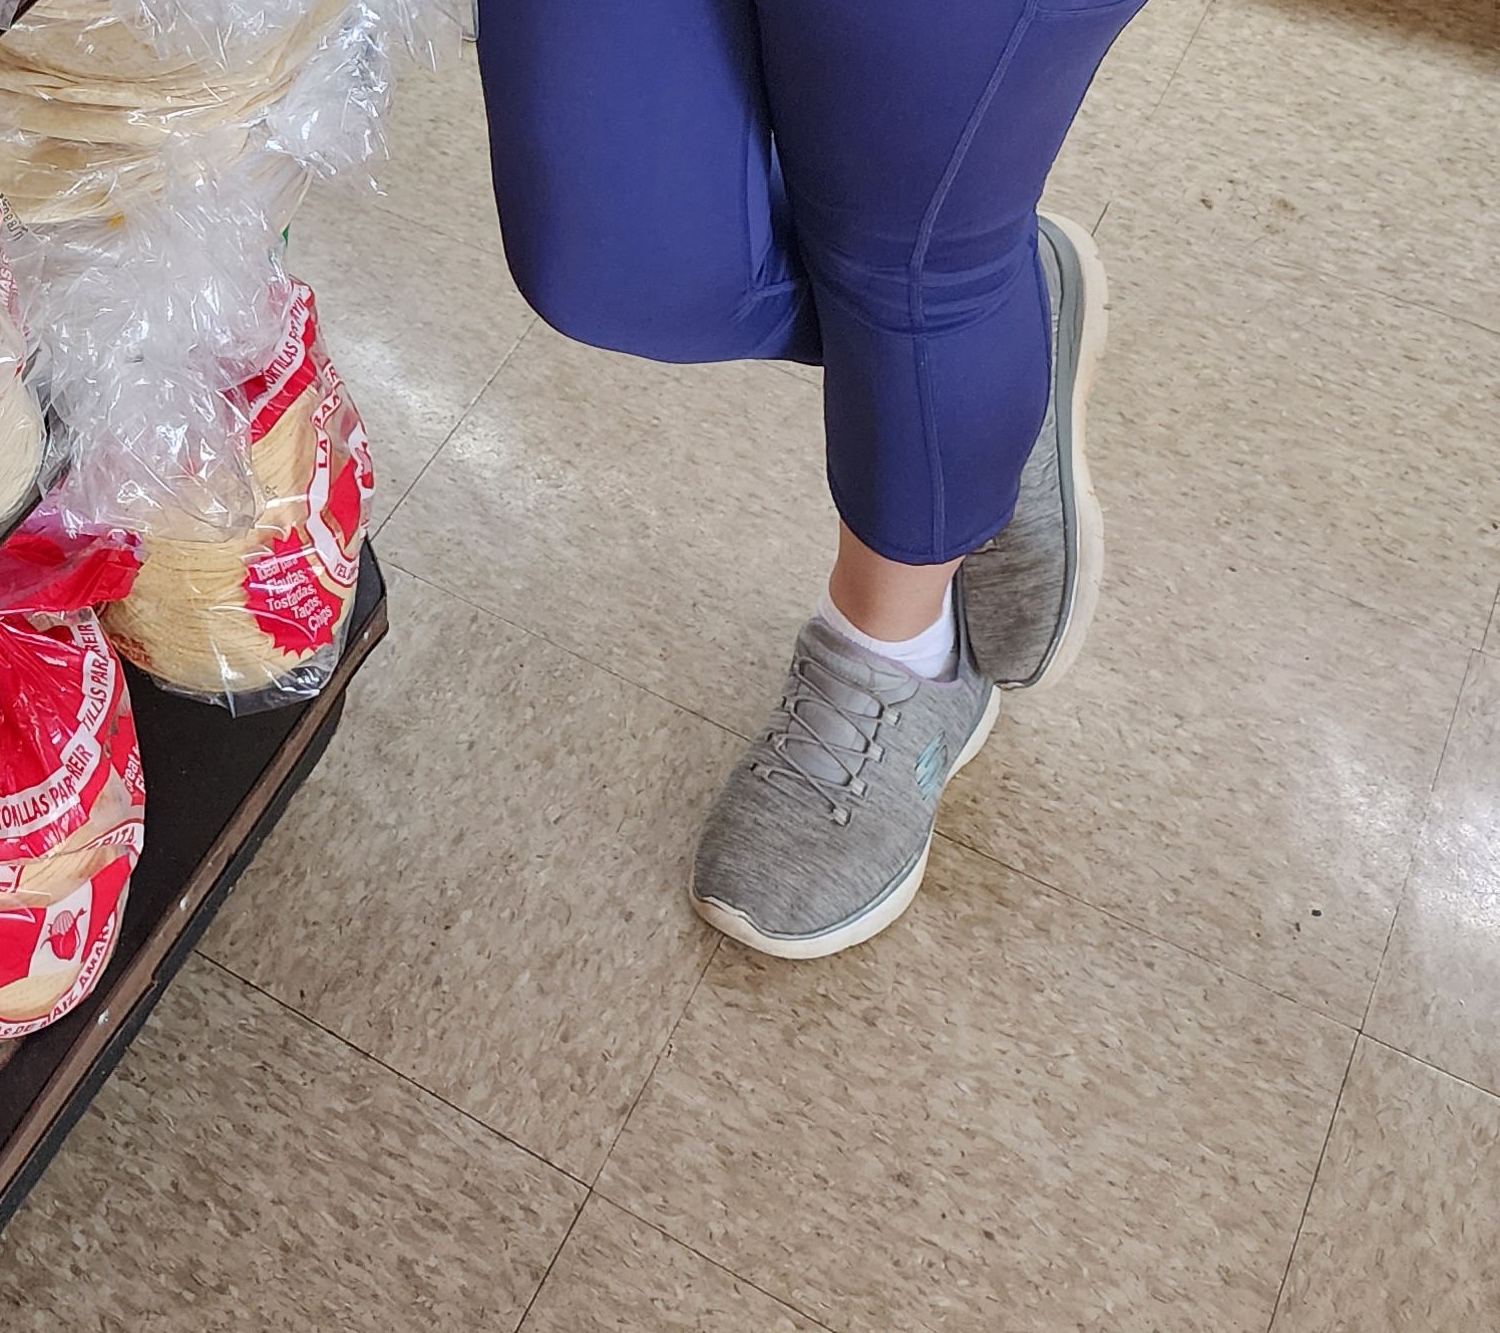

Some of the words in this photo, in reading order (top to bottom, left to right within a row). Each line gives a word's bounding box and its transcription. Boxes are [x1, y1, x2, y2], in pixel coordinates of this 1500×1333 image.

[317, 437, 329, 470] LA
[266, 567, 309, 597] Flautas,
[266, 585, 319, 613] Tostadas,
[291, 594, 324, 621] Tacos,
[308, 603, 334, 633] Chips
